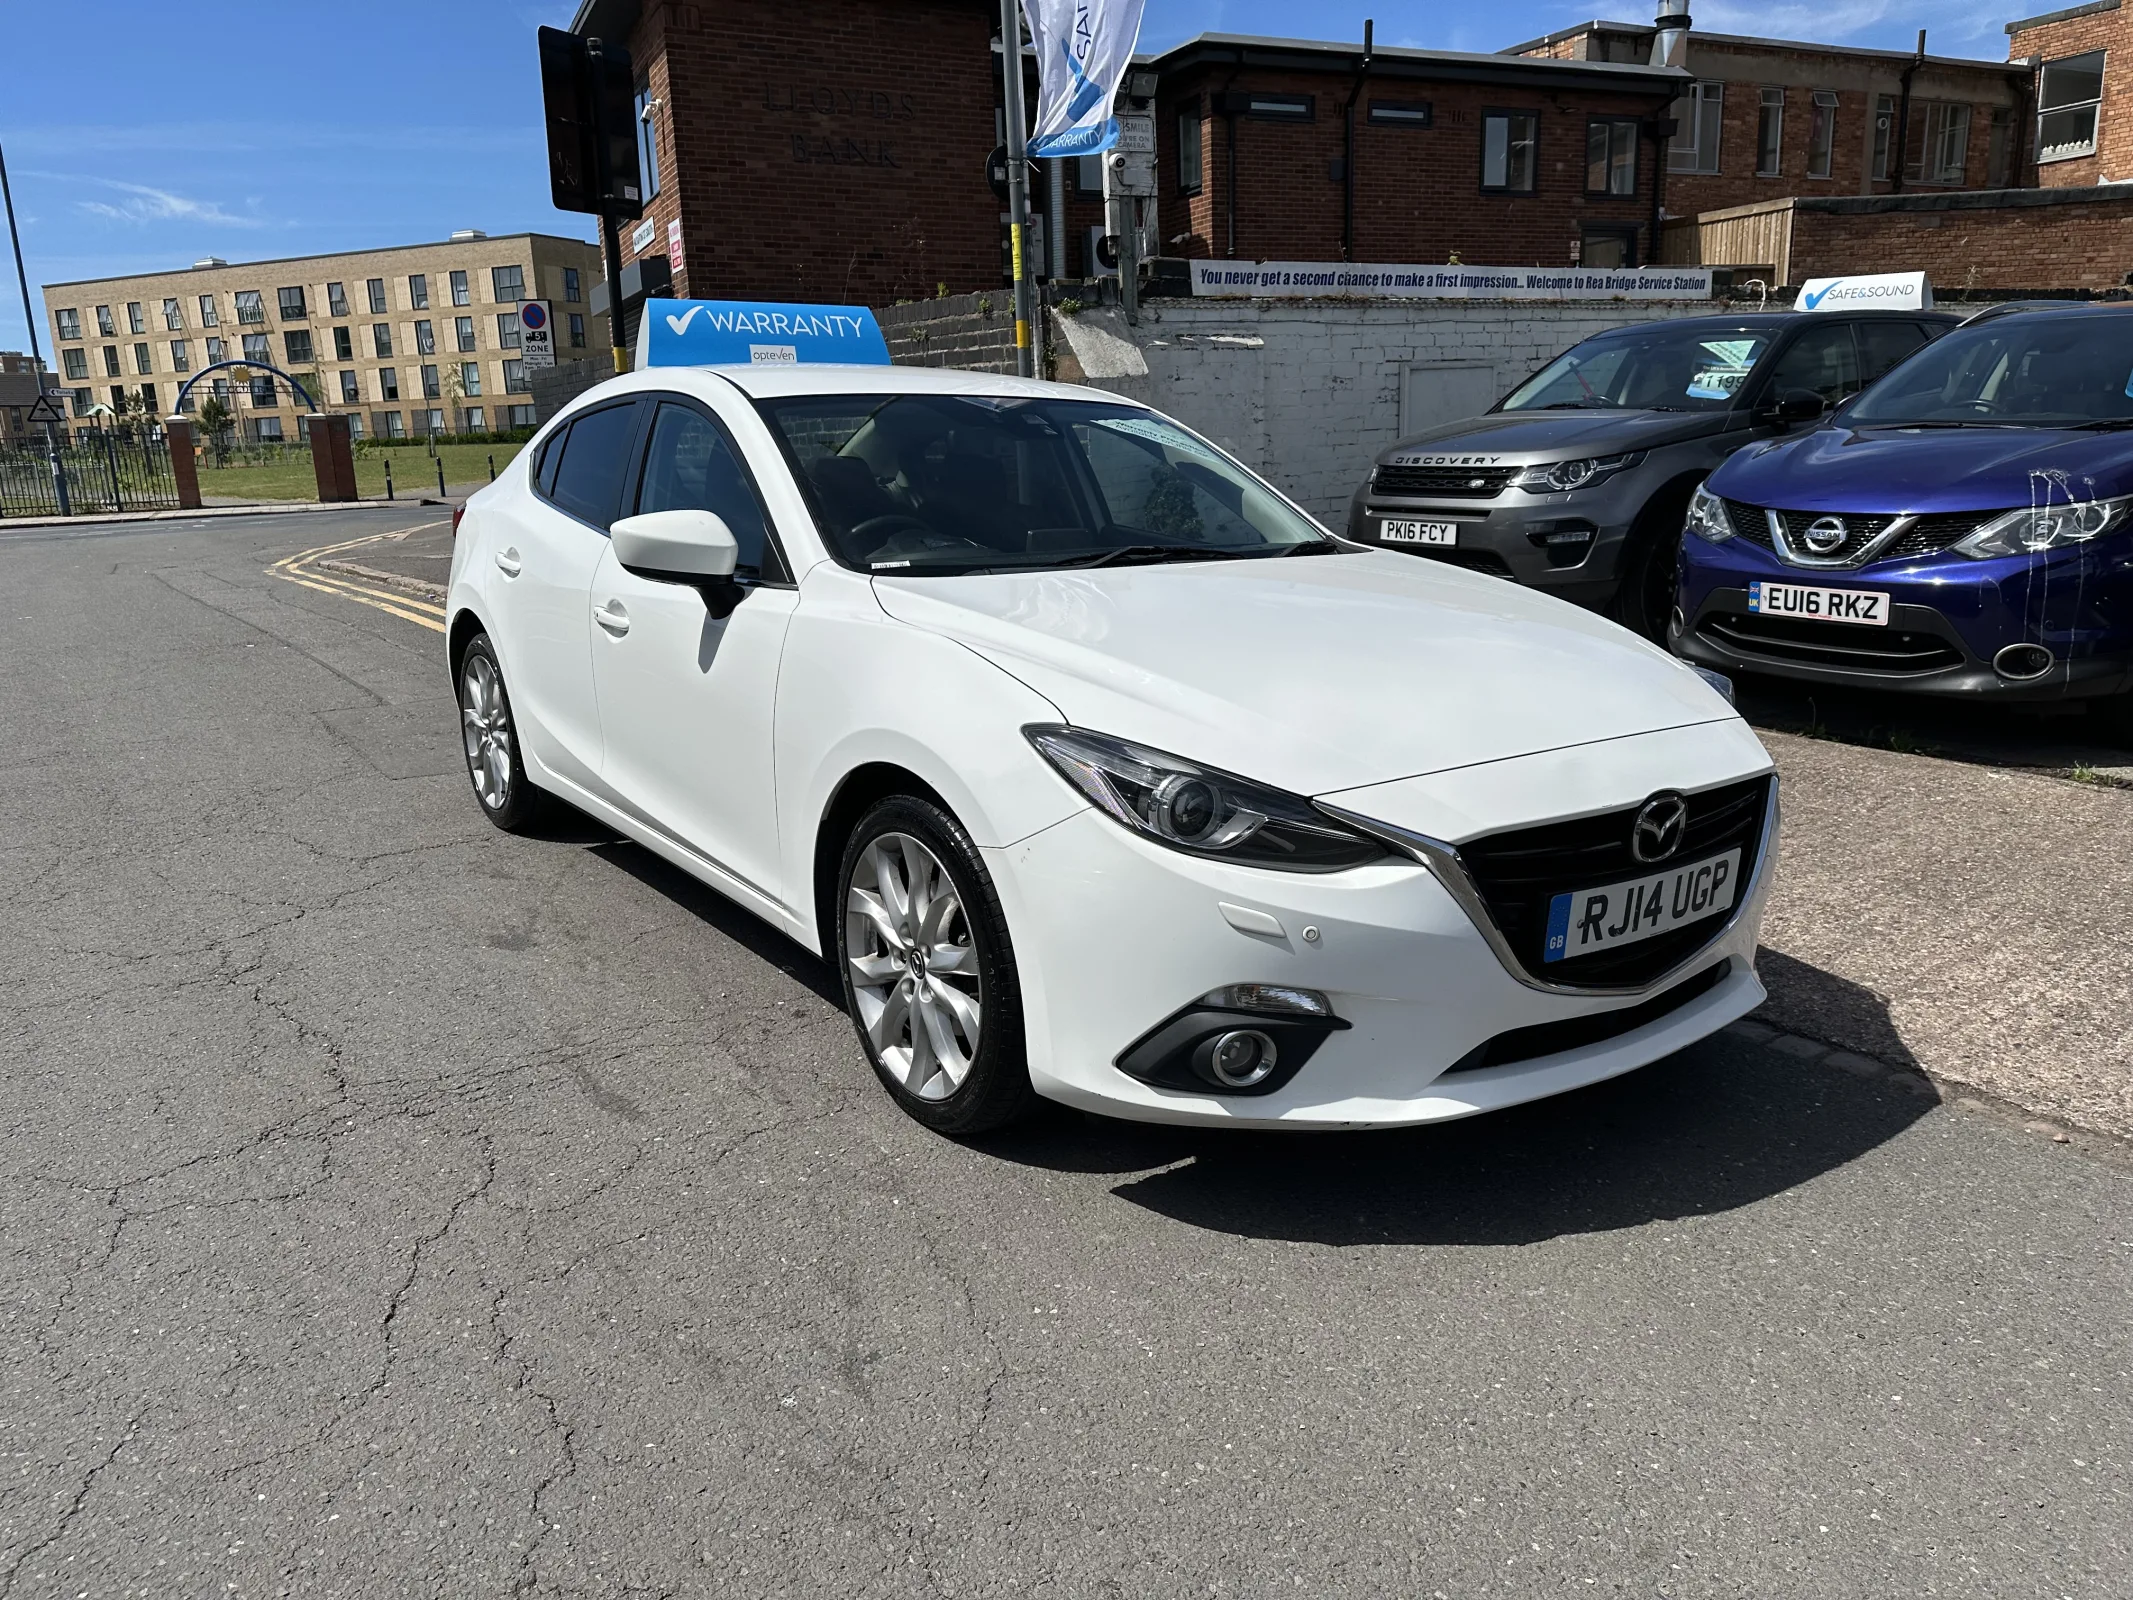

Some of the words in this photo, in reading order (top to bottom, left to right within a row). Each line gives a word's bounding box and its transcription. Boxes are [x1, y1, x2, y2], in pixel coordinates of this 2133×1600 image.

[762, 82, 916, 120] LLOYDS
[791, 133, 902, 168] BANK
[1200, 268, 1222, 284] You
[1224, 270, 1258, 285] never
[1261, 270, 1282, 287] get
[1283, 273, 1290, 286] a
[1292, 271, 1334, 286] second
[1337, 272, 1378, 286] chance
[1381, 273, 1392, 286] to
[1394, 272, 1424, 287] make
[1426, 276, 1433, 287] a
[1436, 273, 1459, 288] first
[1460, 274, 1524, 290] impression...
[1527, 275, 1572, 289] Welcome
[1574, 276, 1584, 289] to
[1586, 276, 1604, 290] Rea
[1605, 276, 1636, 291] Bridge
[1638, 276, 1672, 290] Service
[1674, 276, 1706, 290] Station
[1828, 284, 1914, 300] SAFE&SOUND
[706, 309, 863, 338] WARRANTY
[1396, 456, 1501, 464] DISCOVERY
[1387, 522, 1416, 540] PK16
[1420, 524, 1448, 542] FCY
[1807, 530, 1841, 538] NISSAN
[1748, 598, 1758, 607] UK
[1768, 587, 1820, 614] EU16
[1828, 592, 1879, 620] RKZ
[1580, 880, 1664, 945] RJ14
[1672, 859, 1729, 920] UGP
[1550, 935, 1564, 949] GB
